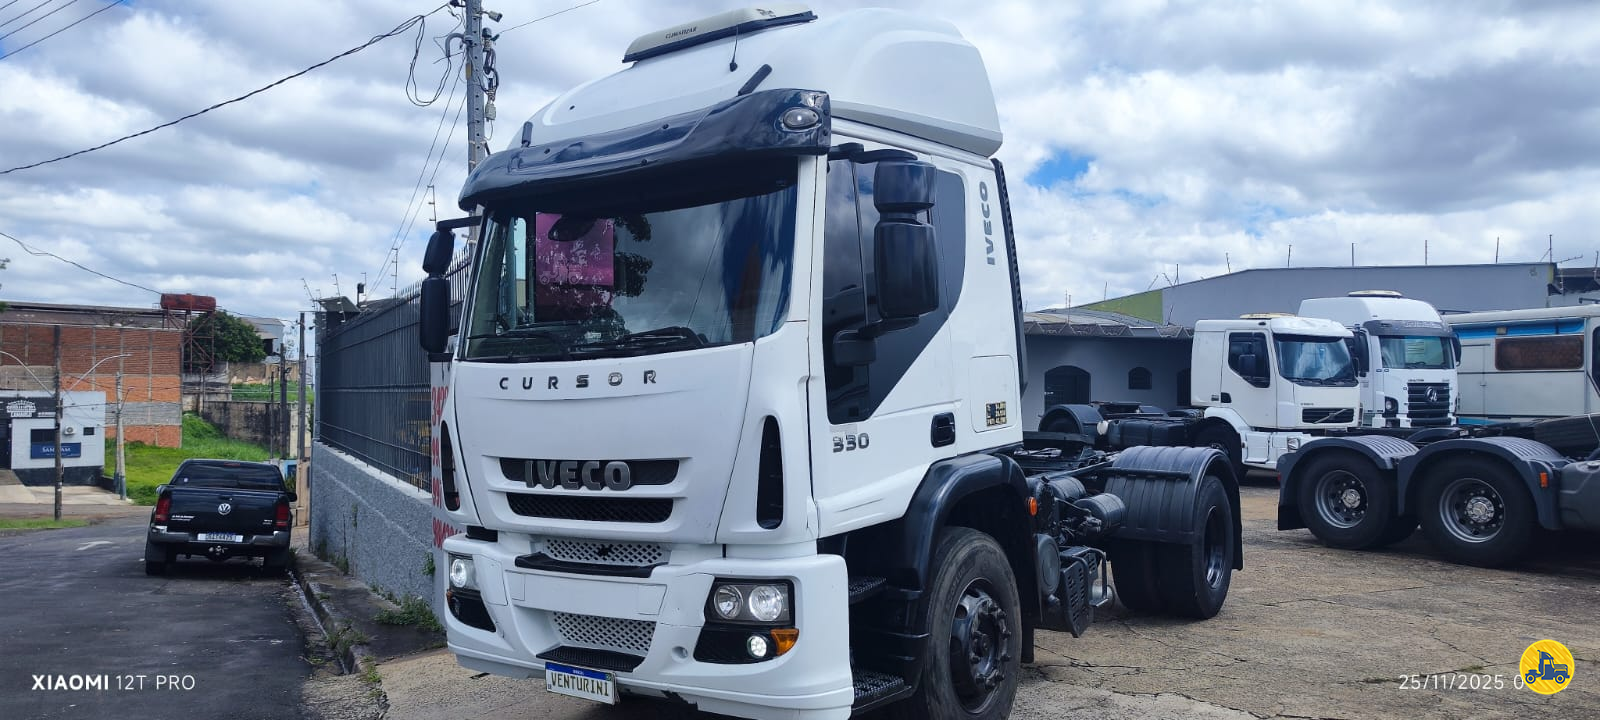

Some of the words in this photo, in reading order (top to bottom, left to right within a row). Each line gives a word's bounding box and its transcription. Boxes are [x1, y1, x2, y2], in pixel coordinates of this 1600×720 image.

[979, 181, 996, 266] IVECO
[499, 369, 657, 390] CURSOR
[832, 432, 870, 454] 330
[524, 459, 631, 491] IVECO
[551, 671, 609, 697] VENTURINI
